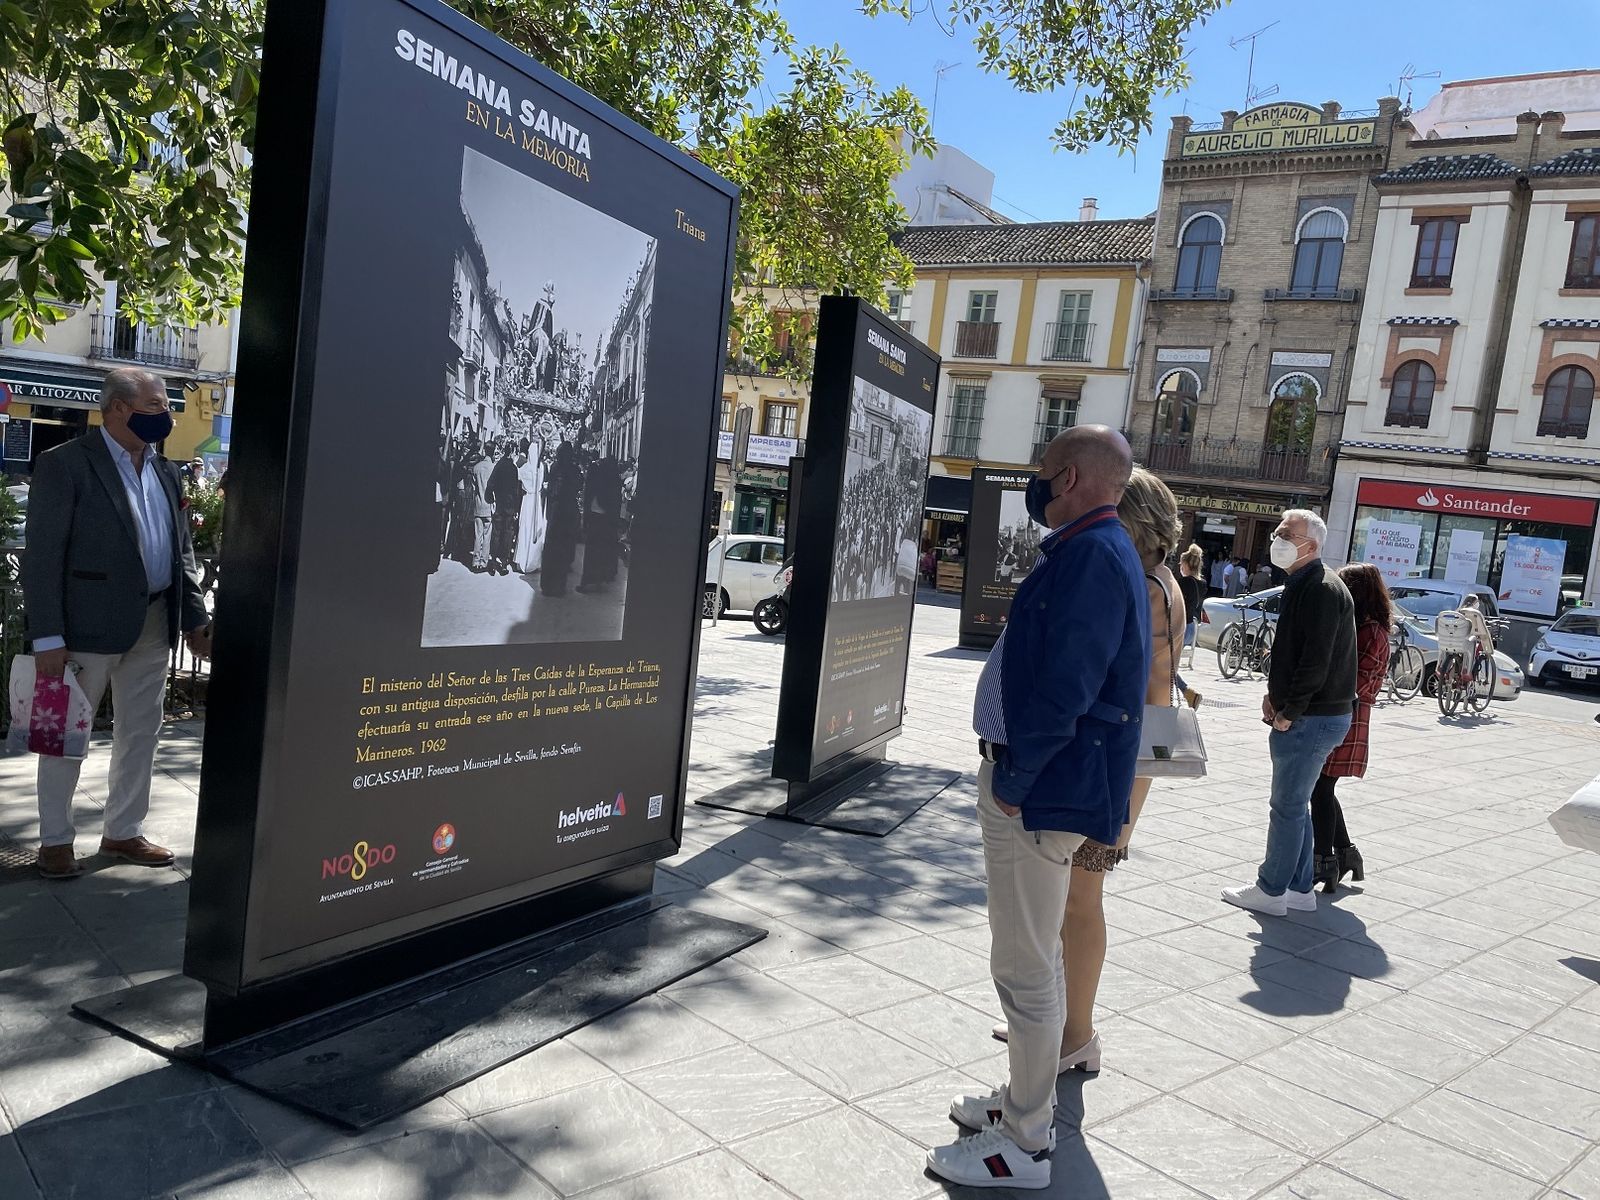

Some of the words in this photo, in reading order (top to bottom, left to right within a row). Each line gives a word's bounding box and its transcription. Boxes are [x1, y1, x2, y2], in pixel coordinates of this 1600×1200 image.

[394, 29, 512, 116] SEMANA
[519, 99, 591, 160] SANTA
[1245, 106, 1310, 127] FARMACIA
[1272, 119, 1282, 127] DE
[465, 100, 490, 132] EN
[495, 118, 516, 144] LA
[522, 130, 590, 182] MEMORIA
[1196, 131, 1273, 153] AURELIO
[1282, 125, 1359, 146] MURILLO
[675, 208, 706, 242] Triana
[868, 328, 890, 354] SEMANA
[890, 344, 906, 364] SANTA
[7, 384, 24, 394] AR
[750, 438, 792, 448] MPRESAS
[1206, 498, 1216, 508] DE
[1222, 500, 1250, 512] SANTA
[1256, 504, 1273, 514] ANA
[1442, 494, 1532, 516] Santander
[362, 677, 374, 694] El
[380, 678, 422, 692] misterio
[427, 673, 443, 688] del
[447, 672, 476, 687] Señor
[480, 670, 491, 684] de
[494, 669, 507, 683] las
[512, 668, 530, 682] Tres
[534, 666, 562, 680] Caídas
[566, 664, 576, 678] de
[578, 662, 585, 677] la
[588, 663, 624, 678] Esperanza
[626, 661, 635, 673] de
[360, 704, 380, 716] con
[385, 704, 397, 713] su
[401, 698, 440, 712] antigua
[444, 692, 498, 708] disposición,
[501, 686, 528, 702] desfila
[532, 690, 546, 701] por
[548, 684, 555, 697] la
[559, 682, 576, 696] calle
[608, 679, 617, 691] La
[620, 676, 659, 690] Hermandad
[358, 720, 410, 740] efectuaría
[417, 722, 429, 731] su
[435, 711, 471, 728] entrada
[477, 714, 491, 723] ese
[496, 710, 512, 721] año
[518, 710, 528, 718] en
[533, 704, 540, 716] la
[545, 705, 569, 716] nueva
[573, 699, 591, 713] sede,
[595, 698, 602, 710] la
[606, 696, 631, 710] Capilla
[634, 694, 643, 705] de
[646, 692, 658, 704] Los
[356, 745, 415, 763] Marineros.
[420, 738, 447, 754] 1962
[427, 765, 459, 777] Fototeca
[463, 754, 501, 771] Municipal
[503, 753, 512, 764] de
[540, 746, 558, 760] fondo
[558, 800, 612, 828] helvetia
[556, 835, 562, 843] Tu
[563, 826, 595, 842] aseguradora
[596, 824, 610, 834] suiza
[322, 841, 396, 880] NO8DO
